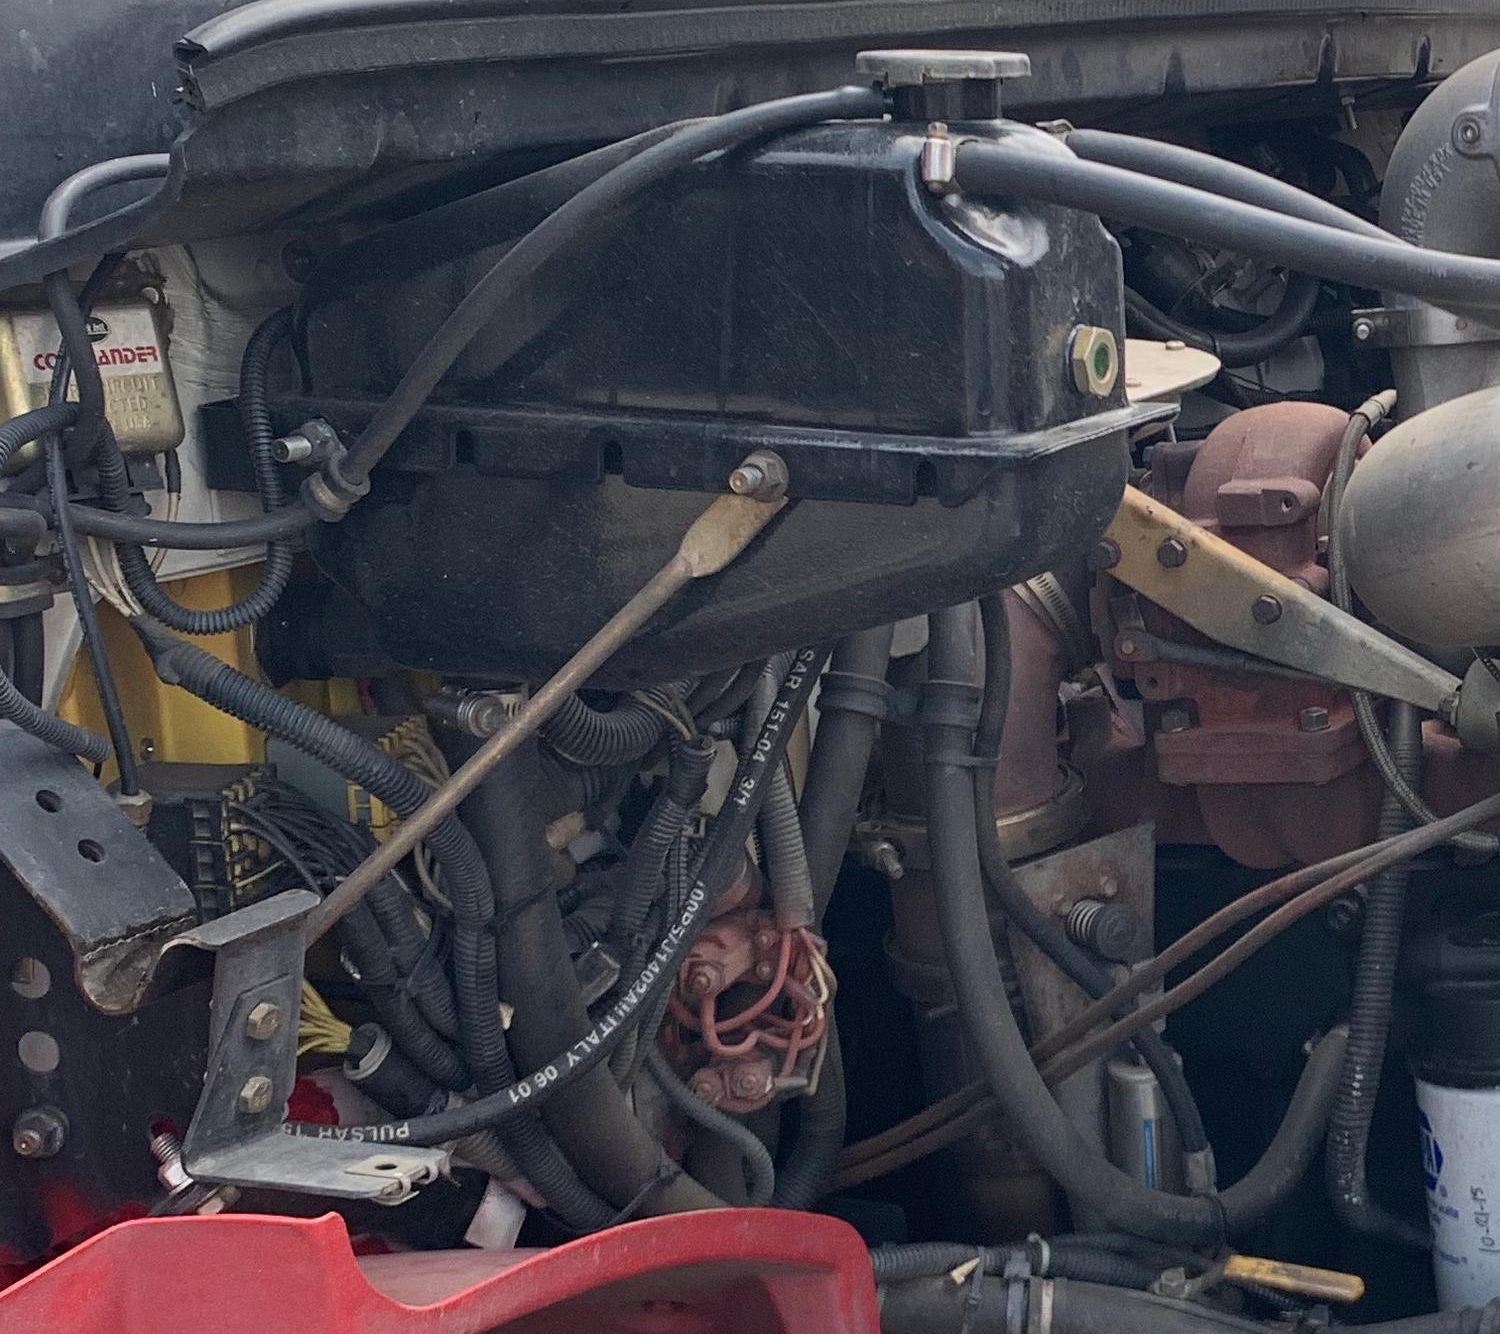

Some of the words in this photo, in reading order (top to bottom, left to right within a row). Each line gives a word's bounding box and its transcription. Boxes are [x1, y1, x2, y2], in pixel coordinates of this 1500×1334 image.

[33, 345, 159, 372] COANDER
[754, 698, 792, 764] 151-04
[565, 1004, 618, 1069] ITALY
[534, 1063, 559, 1089] 06
[508, 1080, 532, 1104] 01
[318, 1121, 411, 1143] PULSAR
